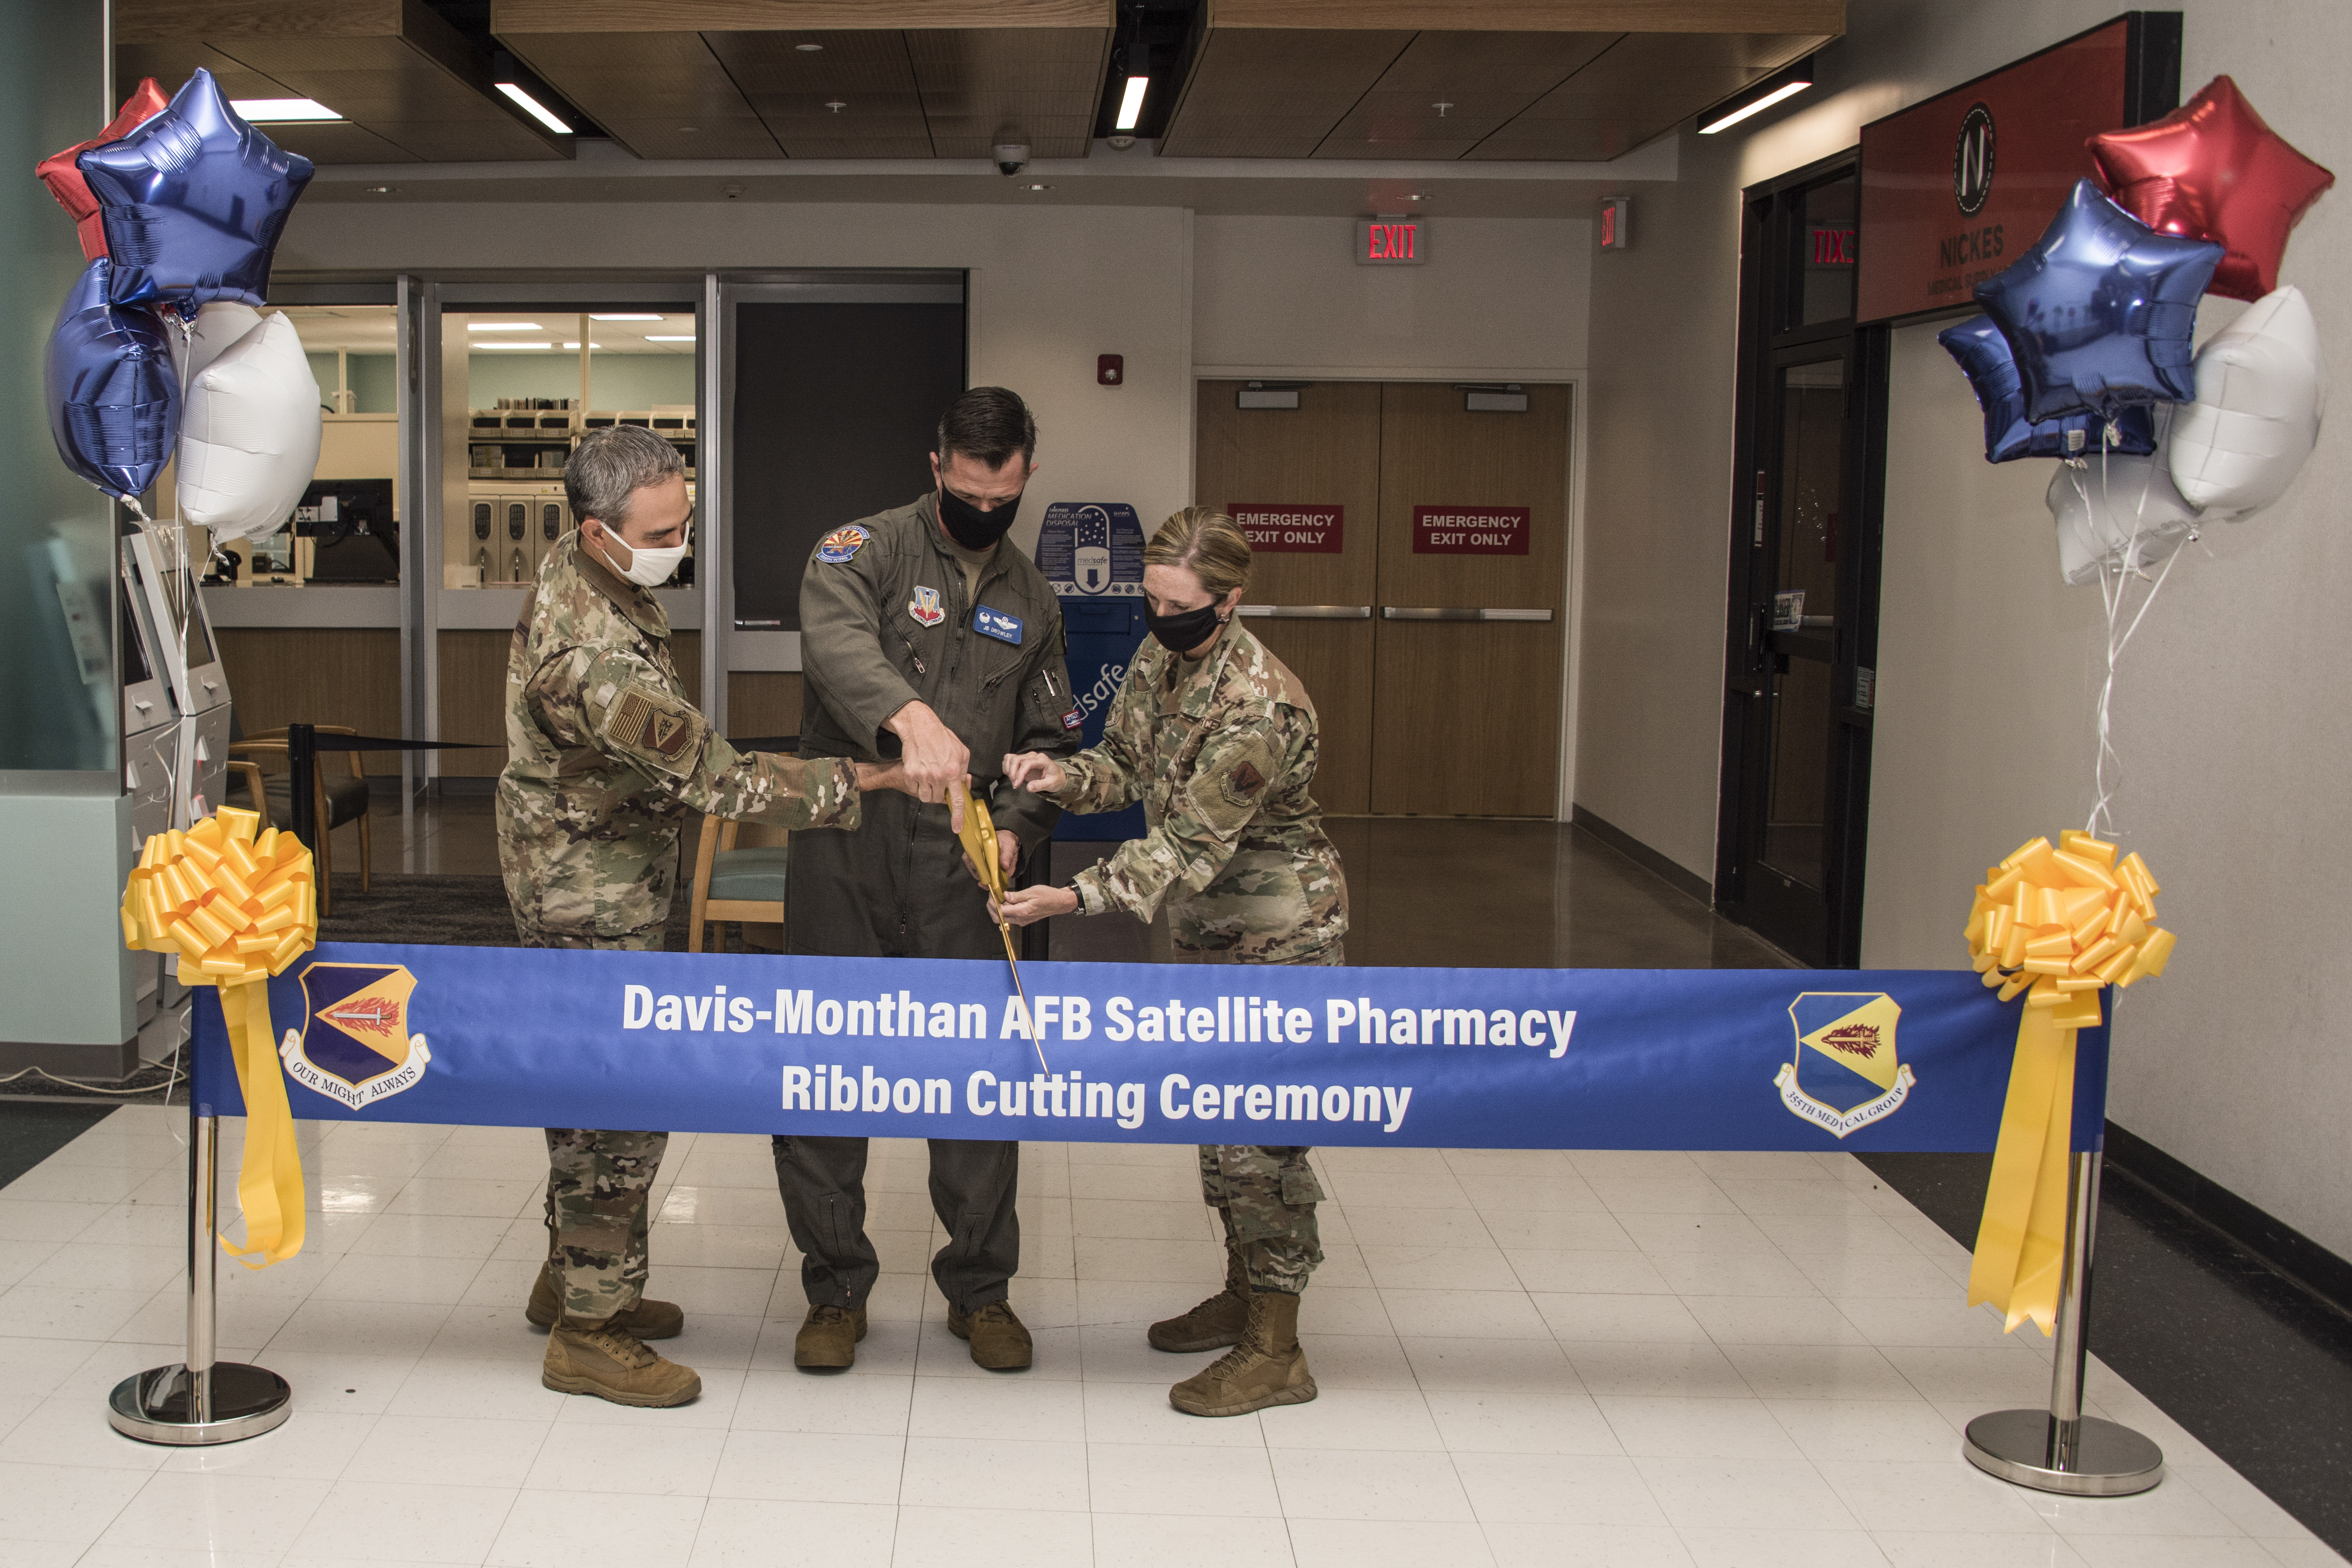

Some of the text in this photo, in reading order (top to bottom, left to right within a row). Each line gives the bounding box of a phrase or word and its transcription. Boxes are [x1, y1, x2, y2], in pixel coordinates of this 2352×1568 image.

[1370, 225, 1416, 259] EXIT
[1940, 224, 2004, 268] NICKES
[1928, 275, 1962, 296] MEDICAL
[1236, 513, 1334, 527] EMERGENCY
[1422, 514, 1521, 529] EMERGENCY
[1246, 530, 1325, 544] EXIT ONLY
[1430, 532, 1512, 546] EXIT ONLY
[1077, 556, 1107, 565] medsafe
[916, 615, 928, 626] COMBAT
[929, 615, 943, 624] COMMAND
[991, 627, 1013, 639] DROWLEY
[1073, 663, 1127, 721] dsafe
[1200, 717, 1220, 730] RCE
[681, 734, 692, 751] MEDICAL
[623, 984, 1577, 1058] Davis-Monthan AFB Satellite Pharmacy
[293, 1062, 416, 1106] OUR MIGHT ALWAYS
[782, 1064, 1412, 1132] Ribbon Cutting Ceremony
[1786, 1087, 1903, 1131] 355TH MEDICAL GROUP
